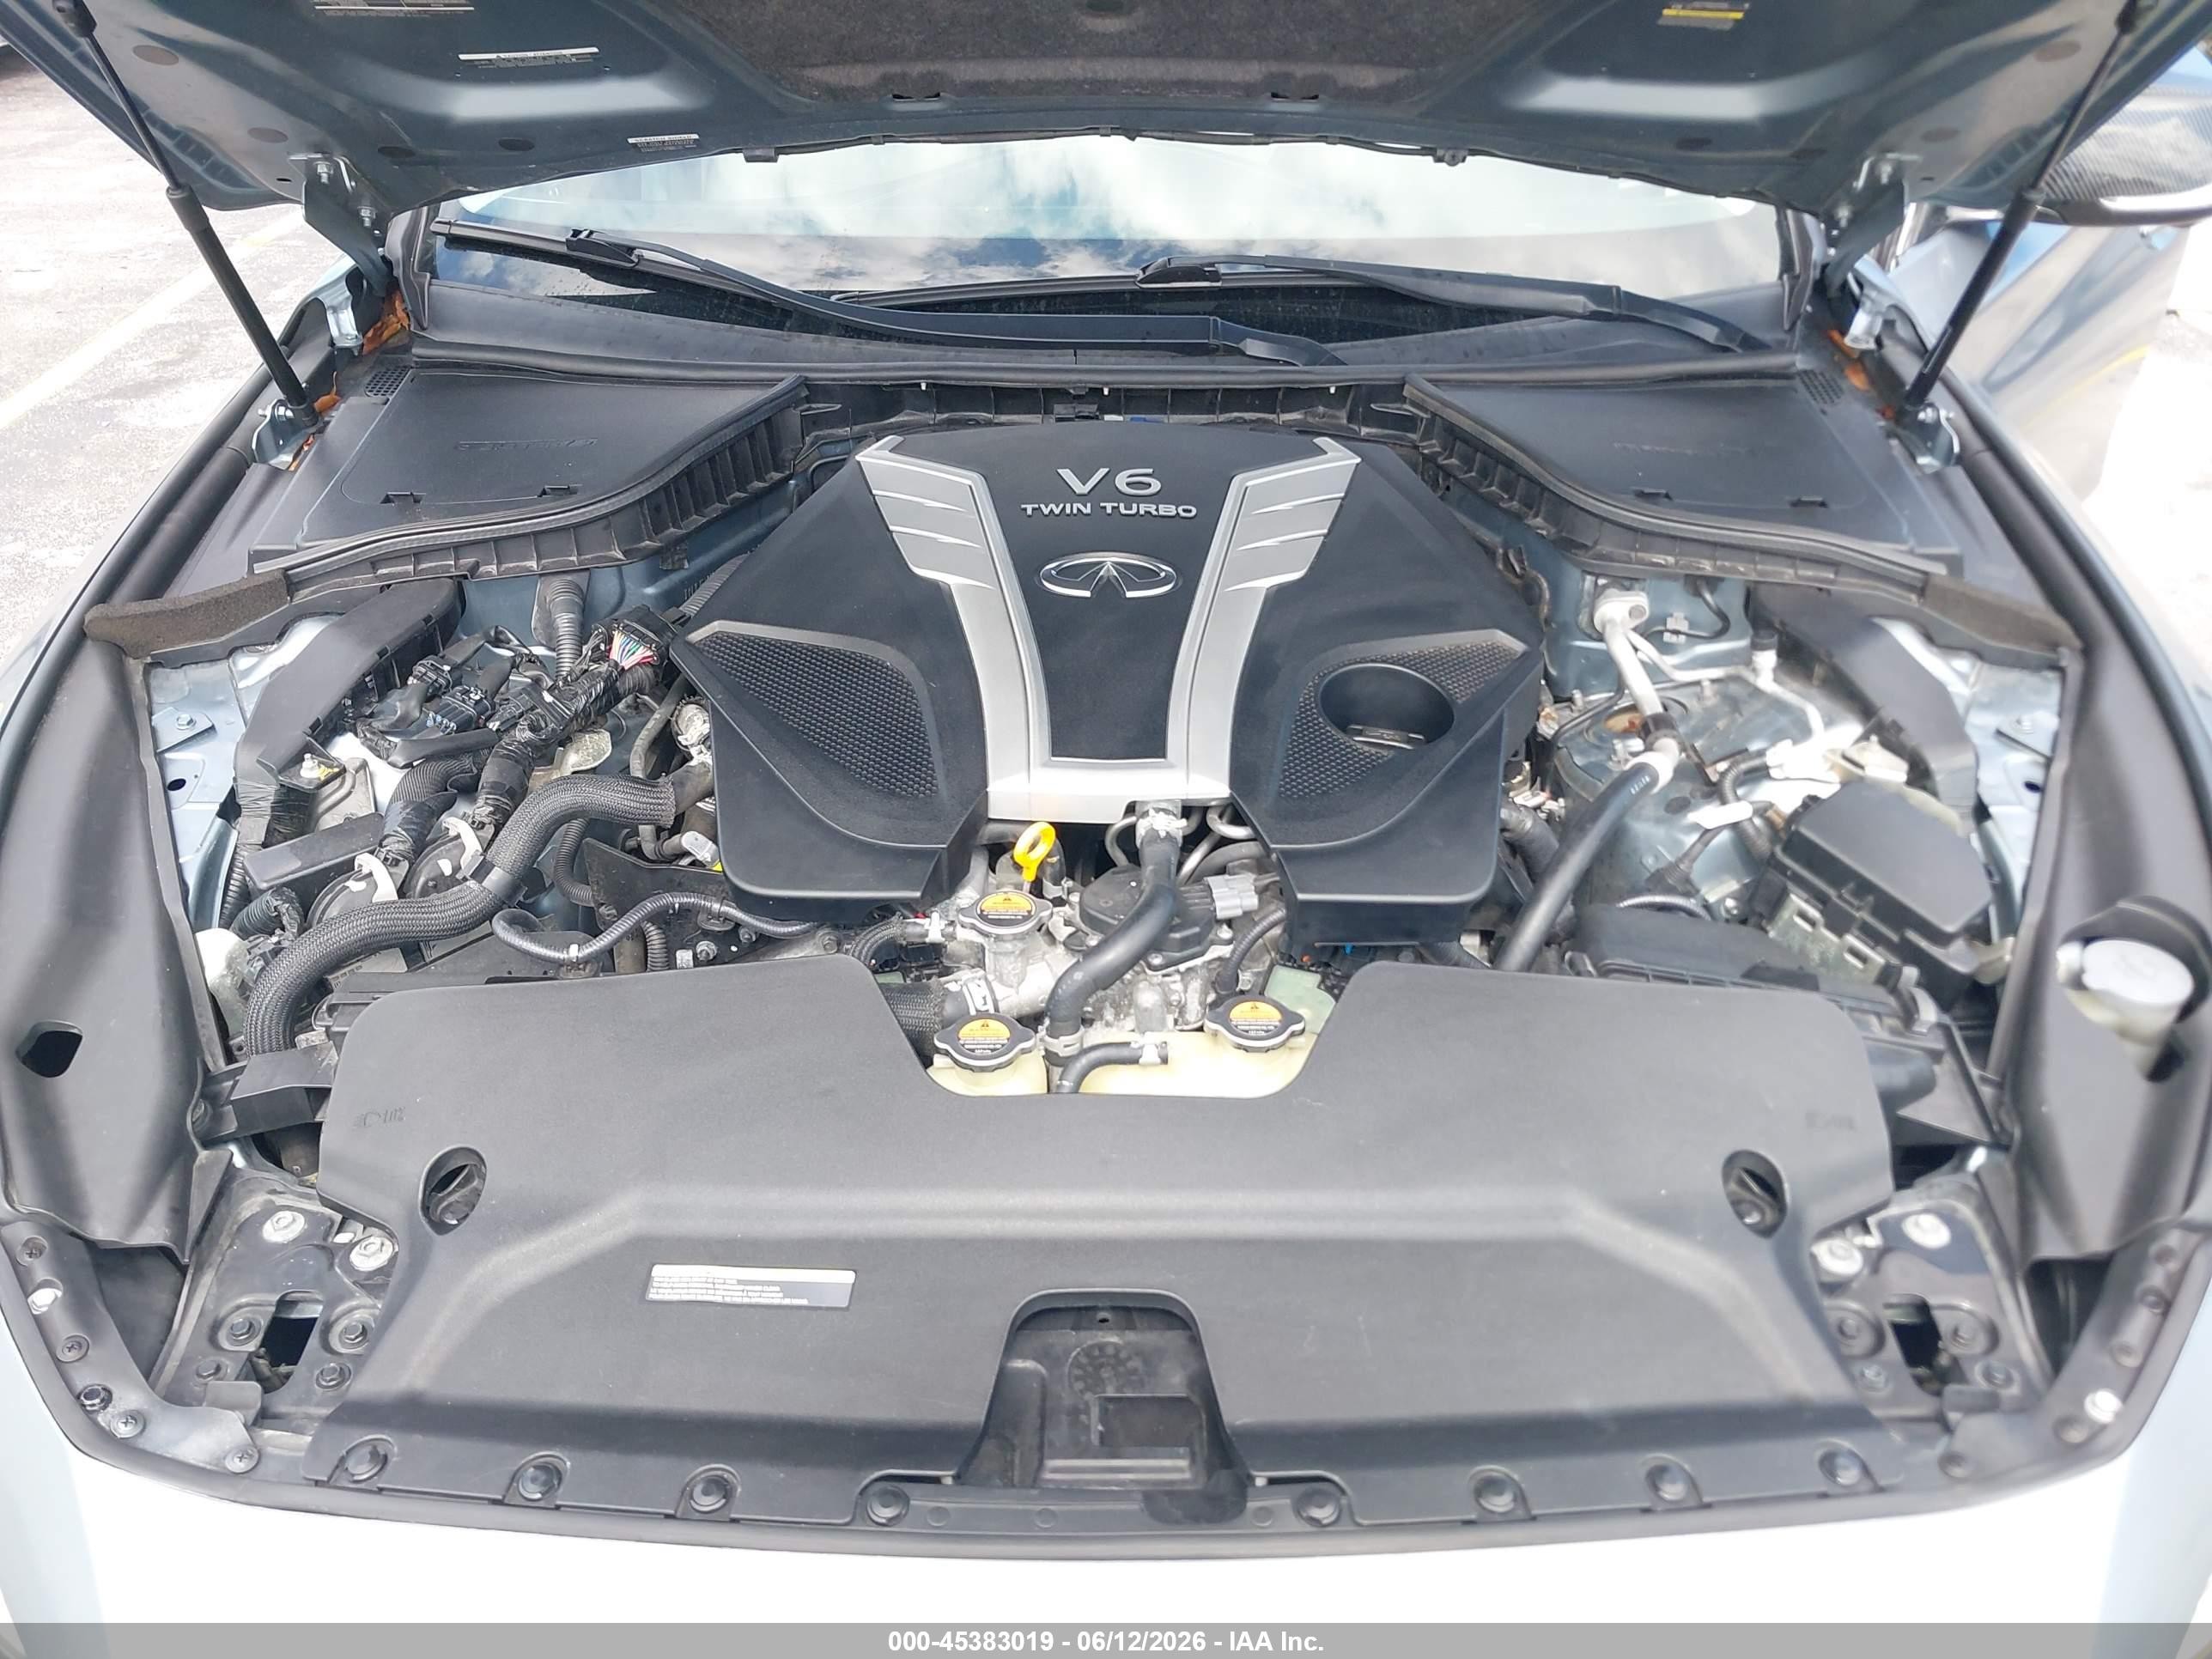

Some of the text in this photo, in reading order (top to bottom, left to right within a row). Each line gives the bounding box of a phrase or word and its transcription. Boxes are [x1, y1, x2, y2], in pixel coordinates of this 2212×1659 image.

[1056, 467, 1162, 496] V6
[1020, 502, 1198, 519] TWIN TURBO
